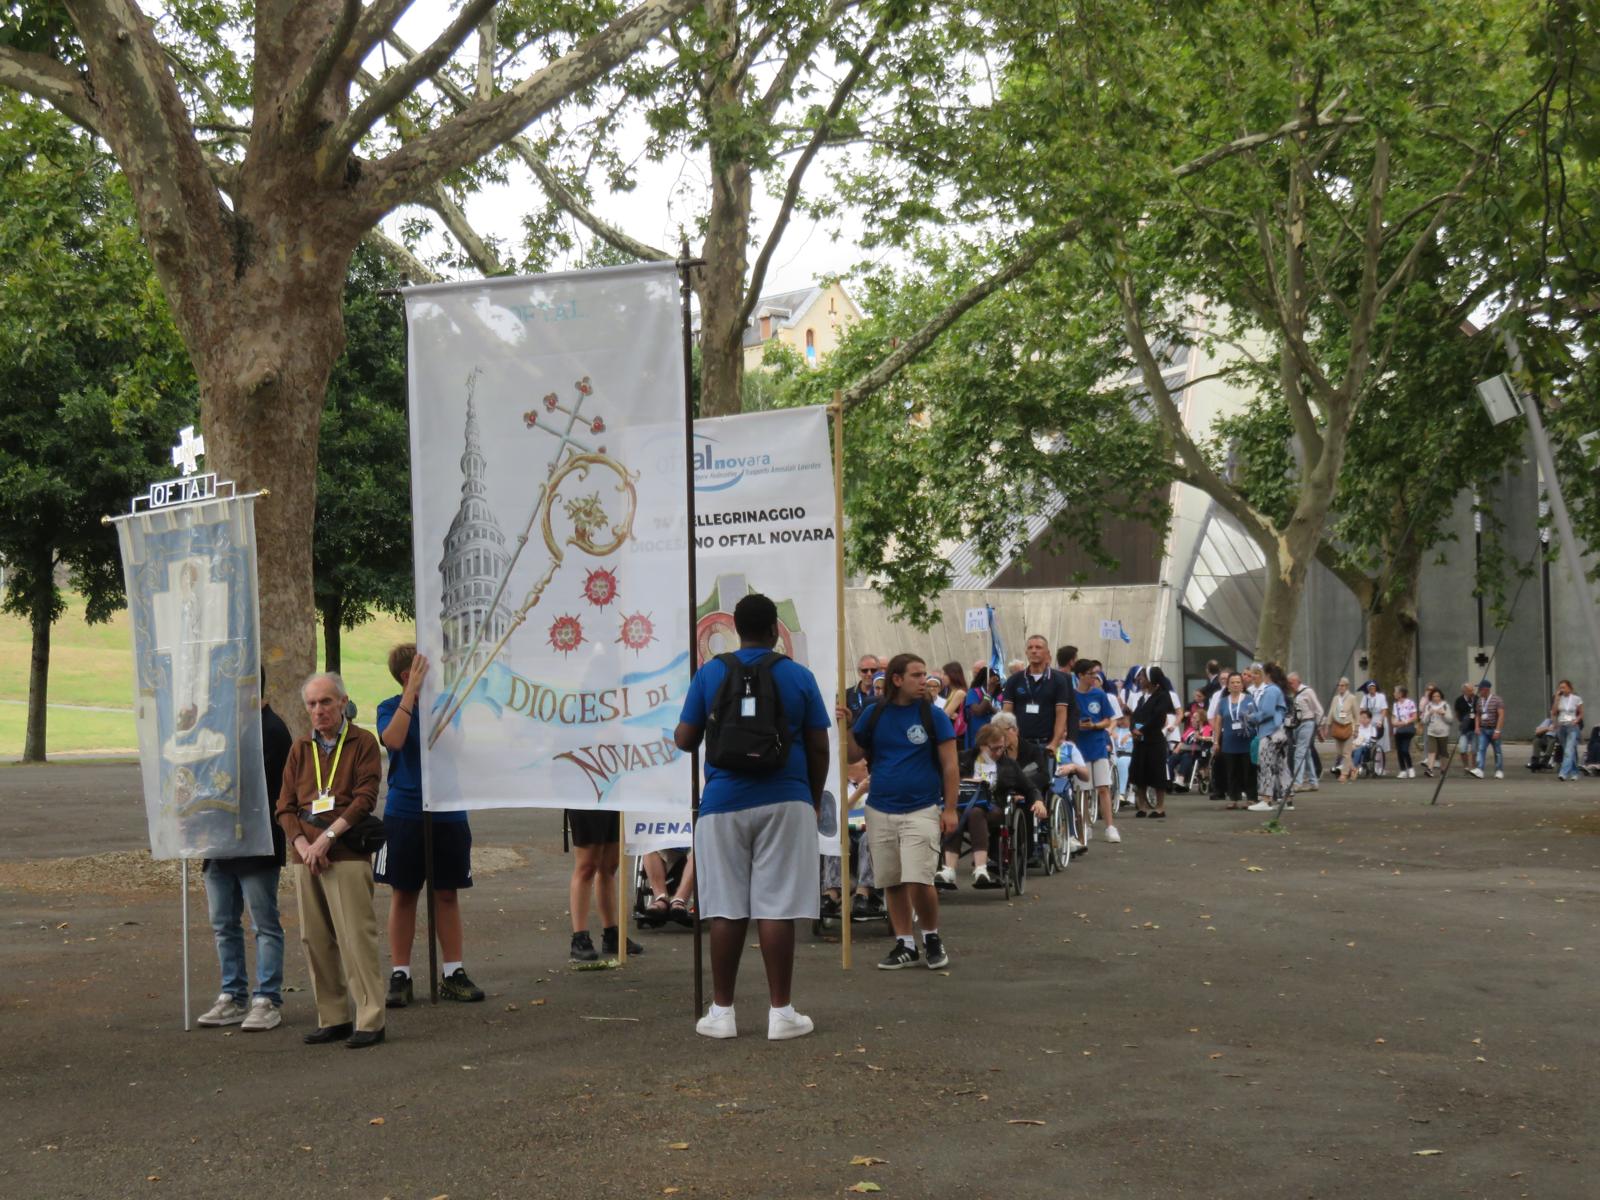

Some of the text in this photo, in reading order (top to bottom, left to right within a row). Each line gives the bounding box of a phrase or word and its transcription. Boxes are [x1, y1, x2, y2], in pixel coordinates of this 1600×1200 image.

[714, 454, 771, 469] novara
[154, 477, 213, 505] OFTAL
[718, 534, 766, 548] OFTAL
[770, 527, 835, 544] NOVARA
[505, 675, 670, 724] DIOCESI DI
[634, 822, 692, 835] PIENA
